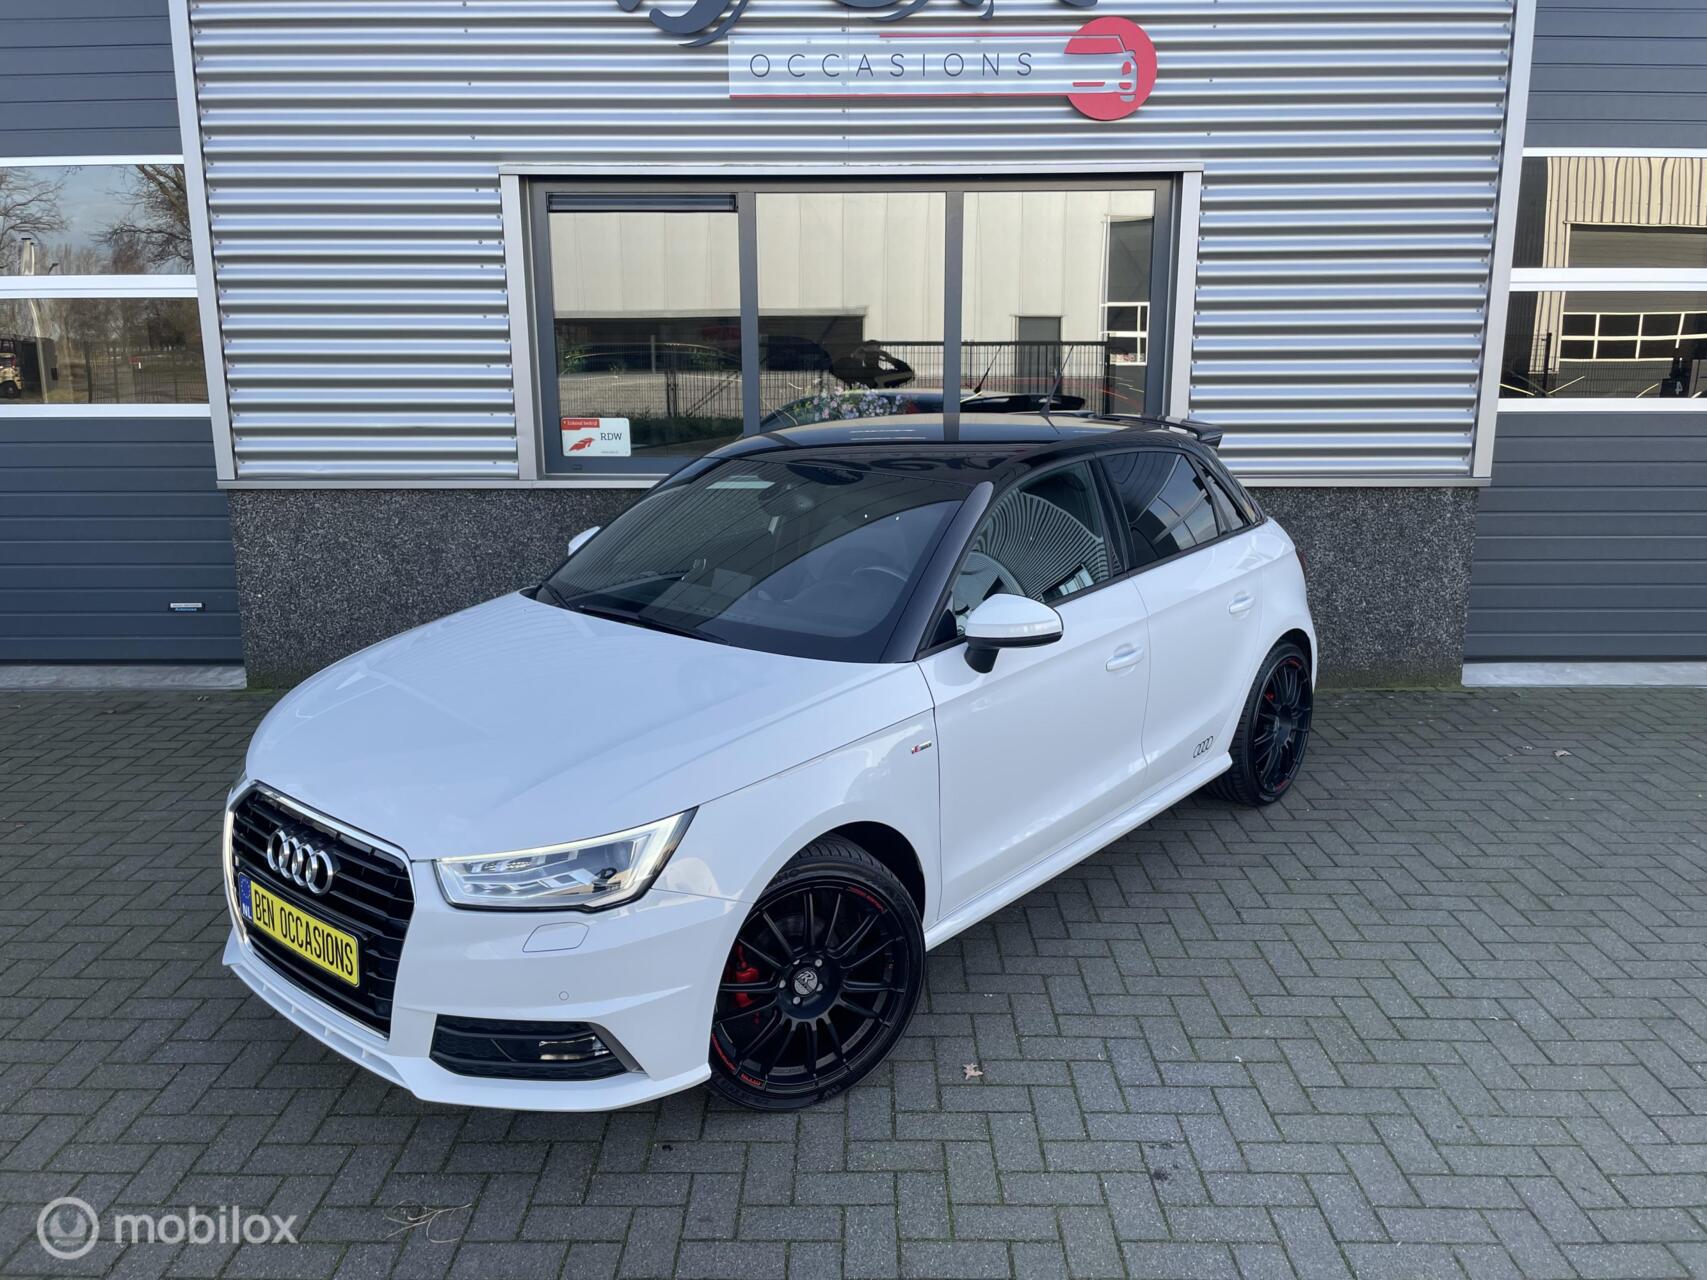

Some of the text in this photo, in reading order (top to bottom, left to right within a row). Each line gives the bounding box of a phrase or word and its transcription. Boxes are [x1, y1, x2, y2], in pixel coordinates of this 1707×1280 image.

[750, 52, 1033, 78] OCCASIONS
[242, 903, 252, 919] NL
[254, 890, 354, 977] BEN OCCASIONS
